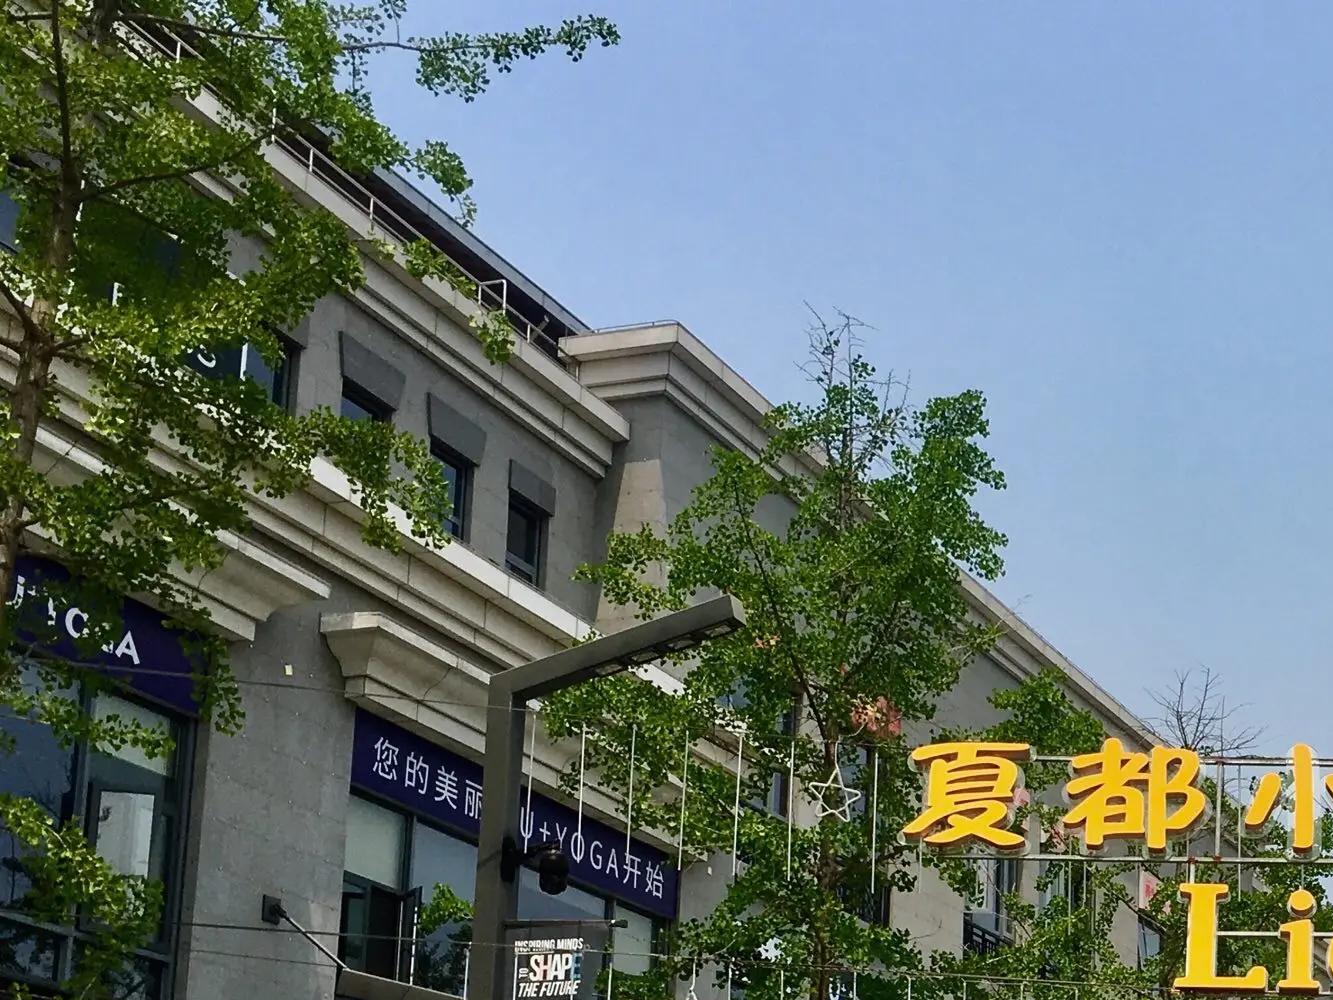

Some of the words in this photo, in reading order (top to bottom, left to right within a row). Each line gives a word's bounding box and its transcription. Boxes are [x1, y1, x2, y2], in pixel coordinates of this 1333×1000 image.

[556, 937, 584, 950] MINDS
[529, 953, 582, 982] SHAPE
[518, 983, 540, 998] THE
[539, 980, 582, 997] FUTURE
